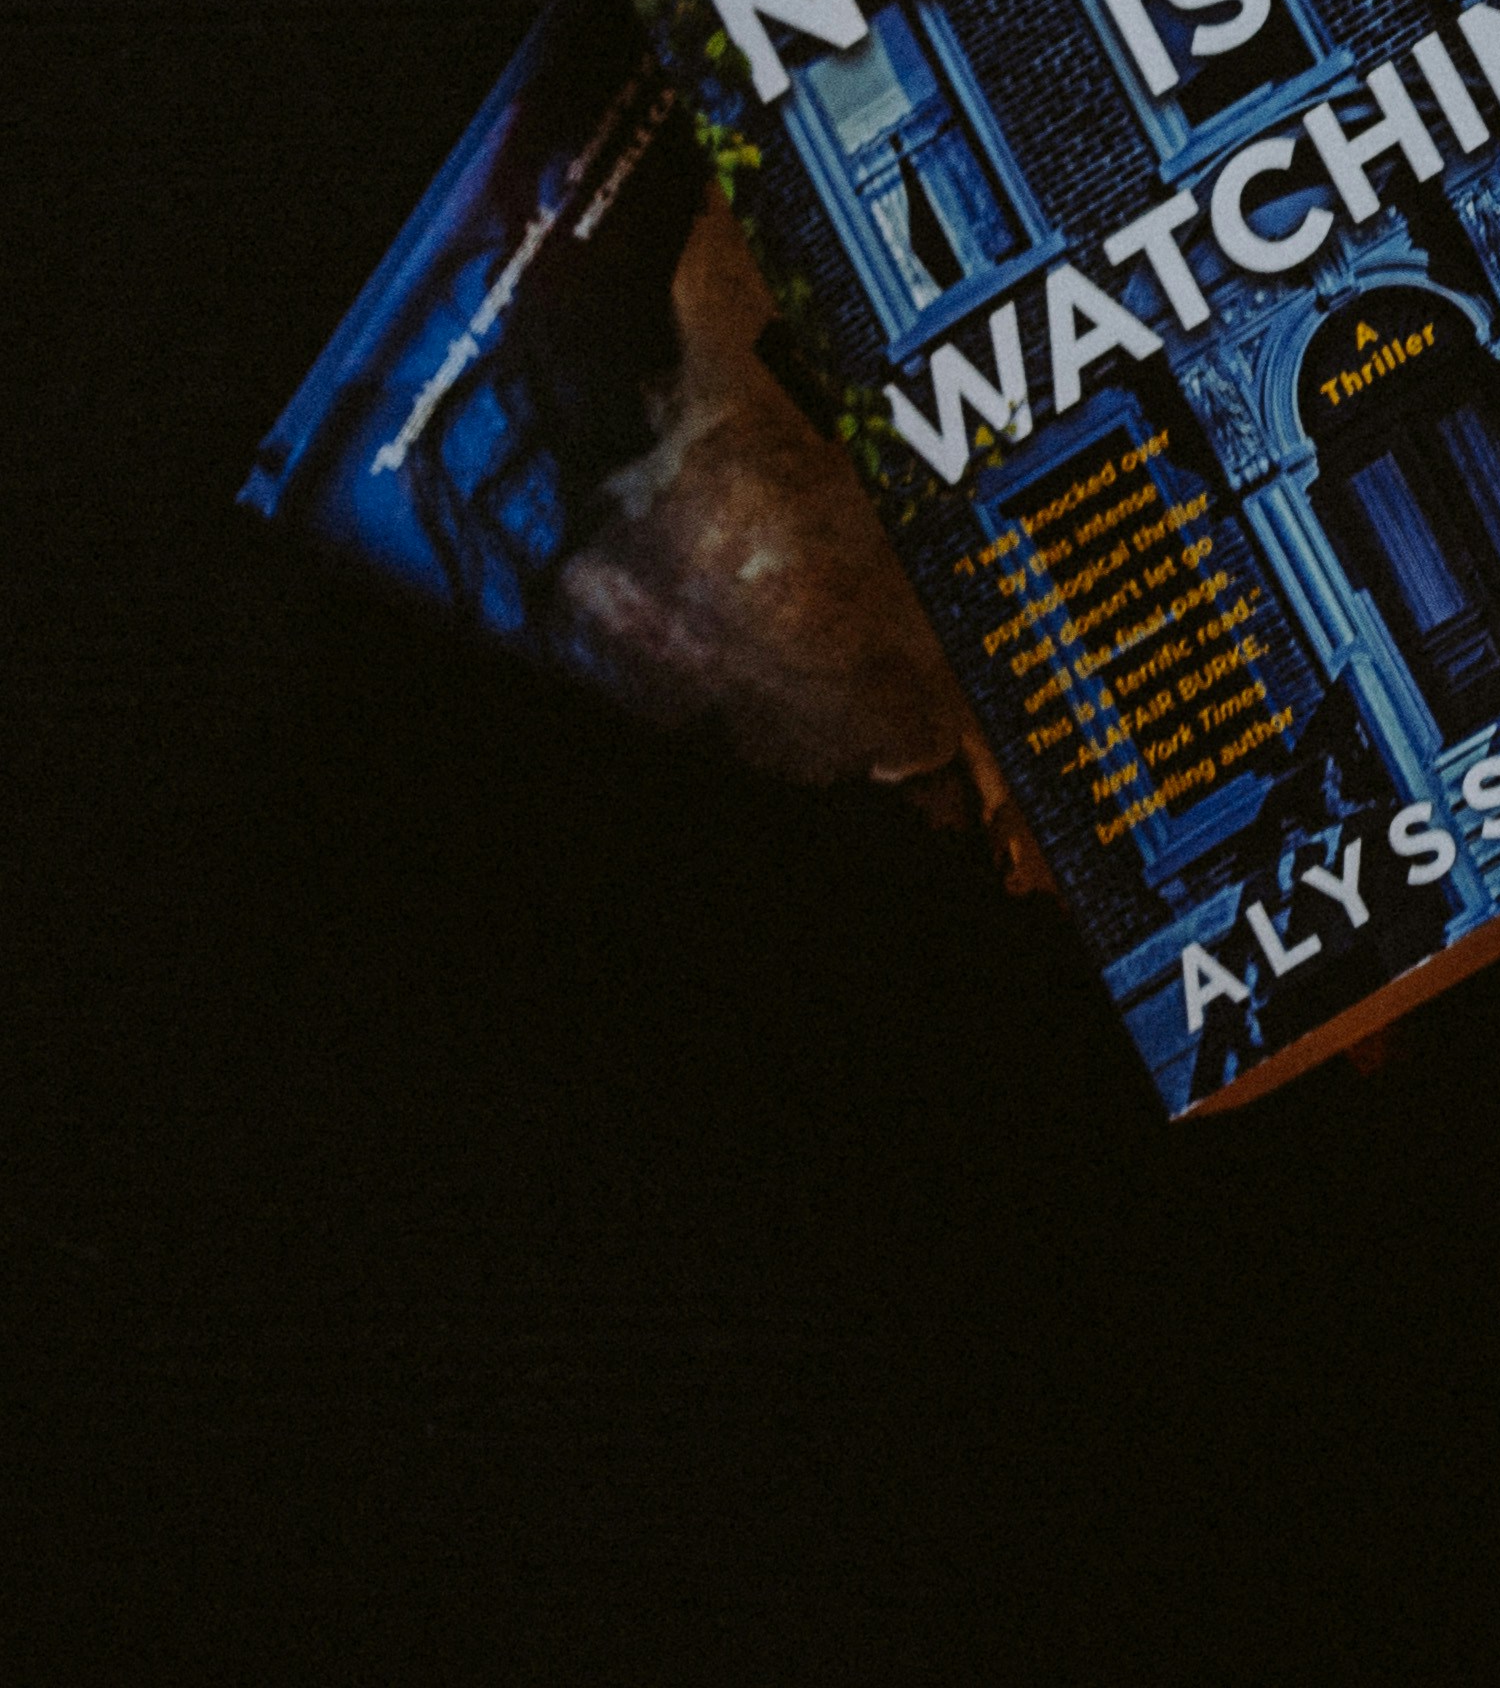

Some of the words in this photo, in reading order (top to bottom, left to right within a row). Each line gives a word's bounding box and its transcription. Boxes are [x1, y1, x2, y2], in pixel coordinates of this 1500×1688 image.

[1318, 320, 1436, 407] Thriller
[1354, 319, 1379, 353] A
[978, 531, 1019, 566] was
[1021, 461, 1116, 536] knocked
[1121, 429, 1169, 472] over
[998, 569, 1026, 596] by
[1030, 539, 1072, 574] this
[1076, 484, 1156, 545] intense
[983, 540, 1130, 656] psychological
[1133, 493, 1207, 552] thriller
[1011, 636, 1056, 676] that
[1143, 556, 1177, 588] let
[1181, 537, 1213, 569] go
[1025, 668, 1072, 713] until
[1074, 646, 1112, 678] the
[1115, 605, 1166, 651] final
[1027, 717, 1072, 754] This
[1115, 639, 1192, 696] terrific
[1092, 762, 1137, 803] New
[1144, 724, 1193, 766] York
[1198, 681, 1266, 731] Times
[1096, 758, 1216, 844] bestselling
[1221, 706, 1293, 765] author
